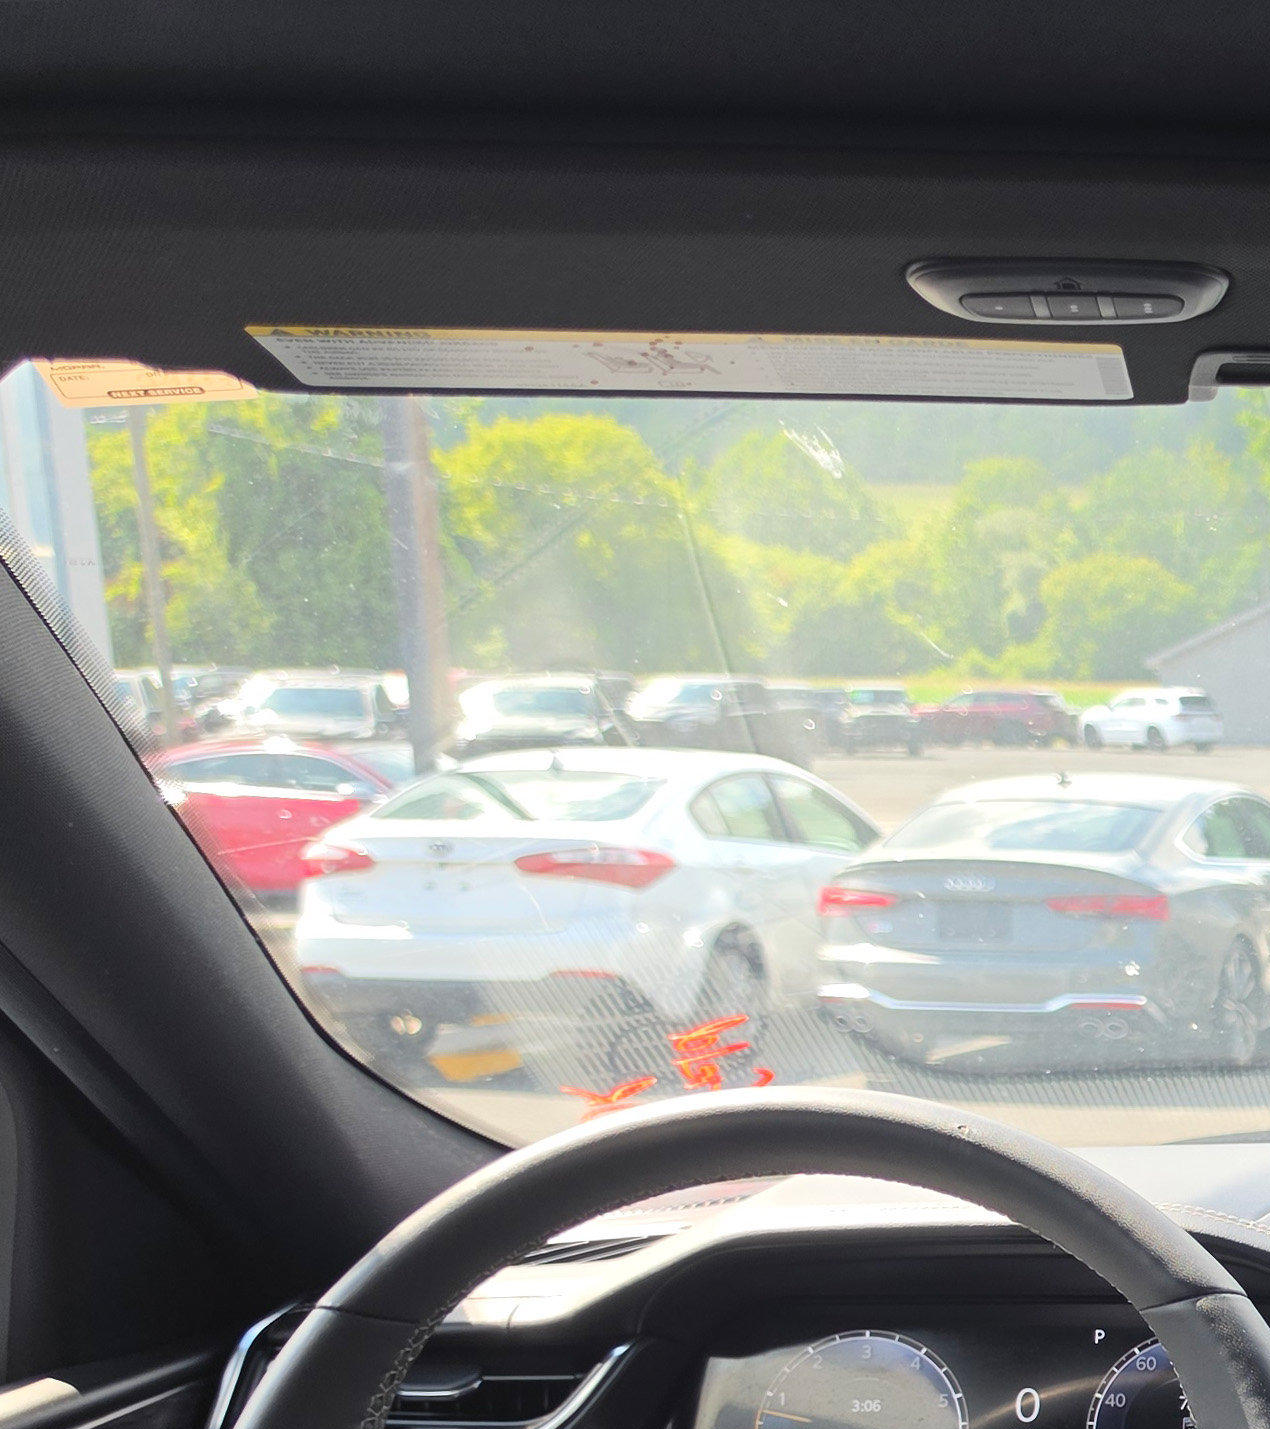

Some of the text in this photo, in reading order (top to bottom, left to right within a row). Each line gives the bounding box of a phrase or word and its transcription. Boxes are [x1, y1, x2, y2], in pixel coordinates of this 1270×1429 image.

[306, 328, 432, 339] WARNING
[58, 374, 90, 382] DATE:
[149, 388, 202, 397] SERVICE
[1094, 1329, 1106, 1344] P
[861, 1344, 872, 1359] 3
[812, 1355, 824, 1370] 2
[910, 1356, 922, 1370] 4
[1135, 1356, 1157, 1371] 60
[779, 1392, 787, 1406] 1
[938, 1393, 949, 1407] 5
[1015, 1387, 1041, 1422] 0
[1104, 1393, 1126, 1407] 40
[851, 1400, 882, 1413] 3:06
